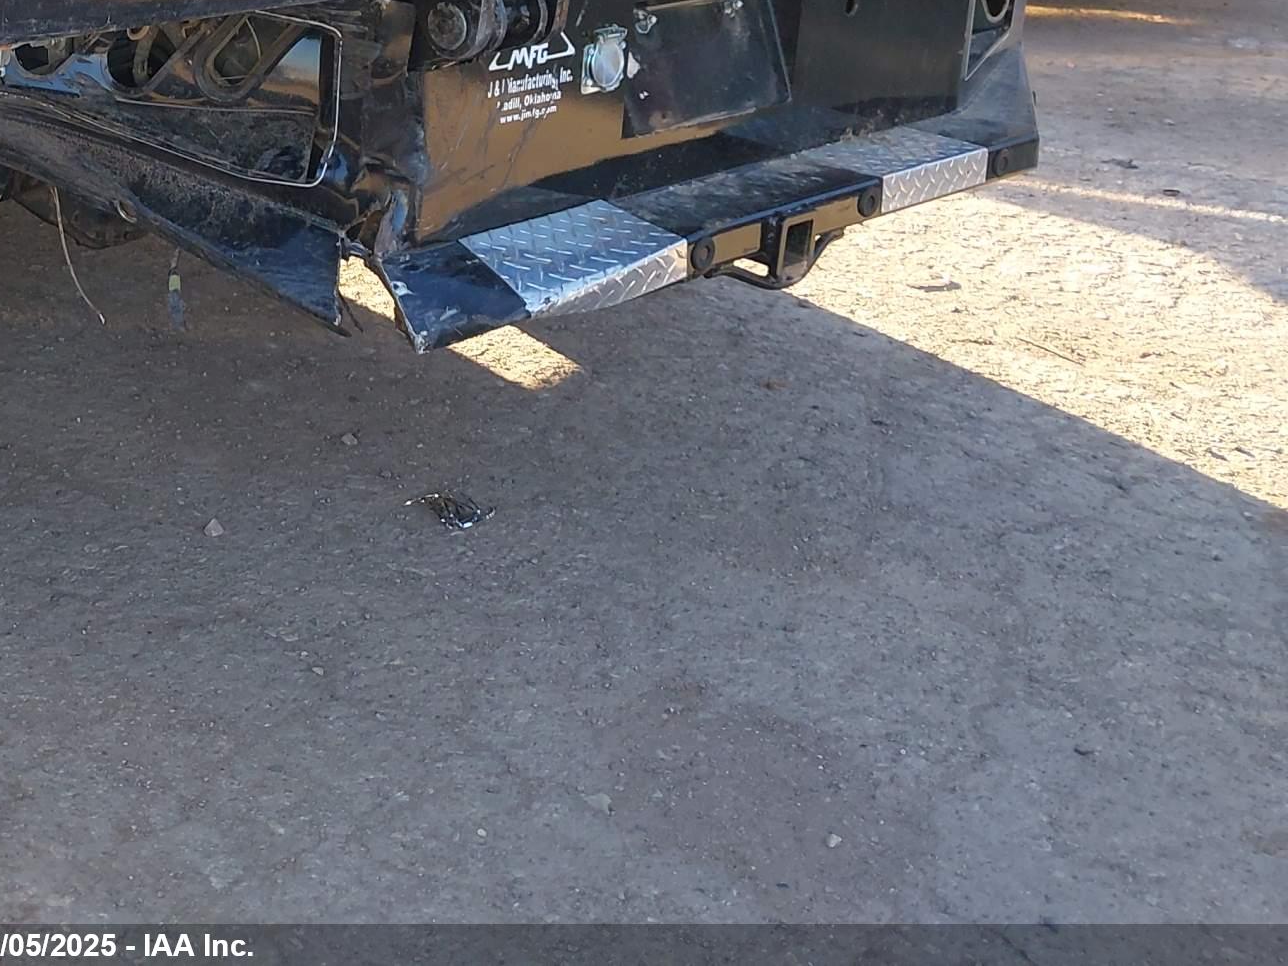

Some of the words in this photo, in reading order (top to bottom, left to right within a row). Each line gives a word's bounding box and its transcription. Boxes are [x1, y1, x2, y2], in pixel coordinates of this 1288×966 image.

[487, 81, 494, 98] J
[494, 79, 500, 97] &
[560, 66, 573, 84] Inc.
